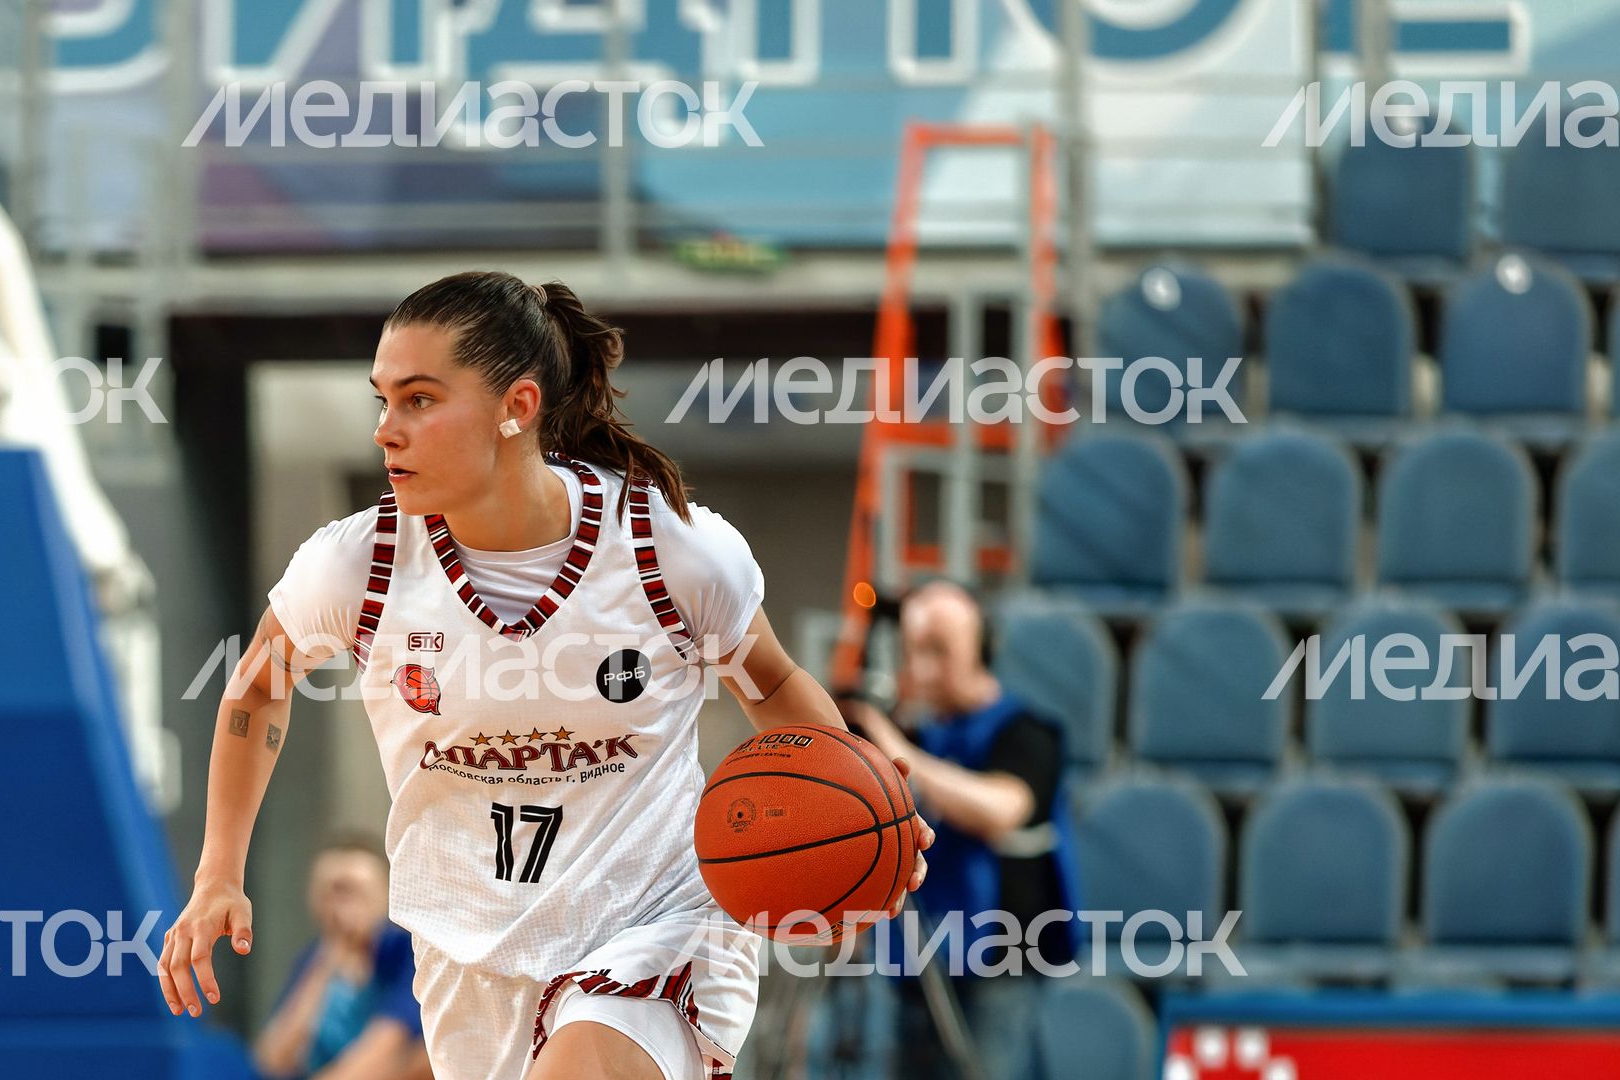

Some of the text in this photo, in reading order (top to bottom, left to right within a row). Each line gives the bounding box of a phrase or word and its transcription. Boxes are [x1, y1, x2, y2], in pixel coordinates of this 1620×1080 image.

[410, 634, 442, 650] STK
[603, 665, 646, 686] РФБ
[508, 773, 562, 786] область
[566, 774, 576, 784] г.
[579, 761, 626, 784] Видное
[490, 801, 564, 884] 17
